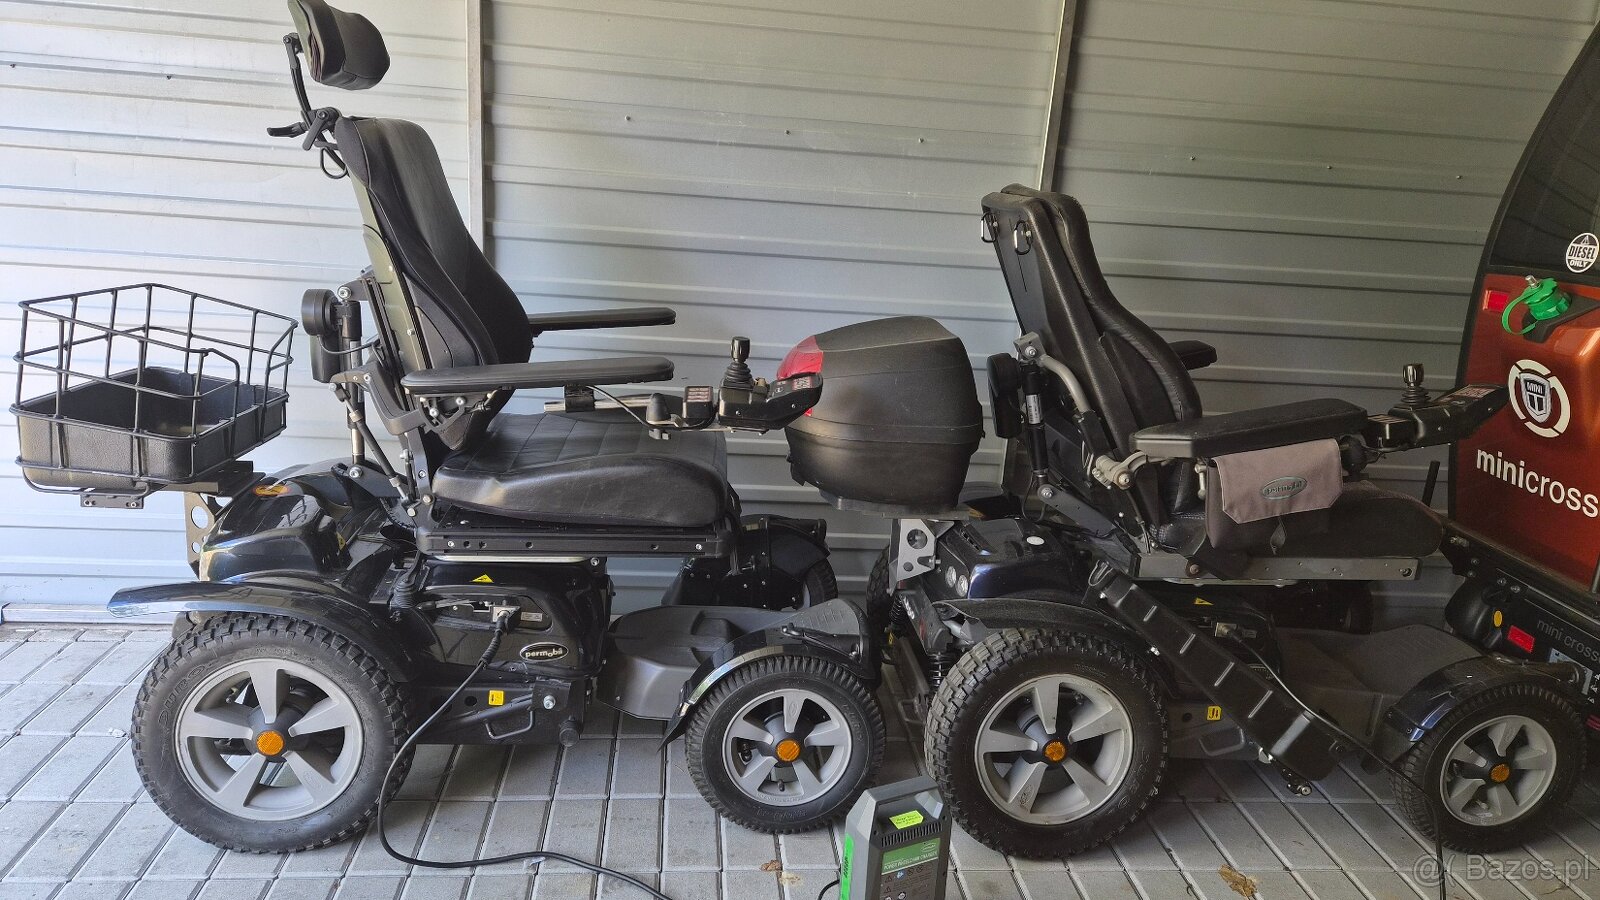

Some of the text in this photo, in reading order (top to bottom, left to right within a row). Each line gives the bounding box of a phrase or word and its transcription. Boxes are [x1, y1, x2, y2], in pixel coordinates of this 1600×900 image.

[1568, 245, 1596, 260] DIESEL
[1569, 259, 1588, 268] ONLY
[1526, 381, 1543, 395] MINI
[1476, 449, 1599, 519] minicross
[1536, 619, 1600, 664] mini cross
[525, 647, 563, 660] permobil
